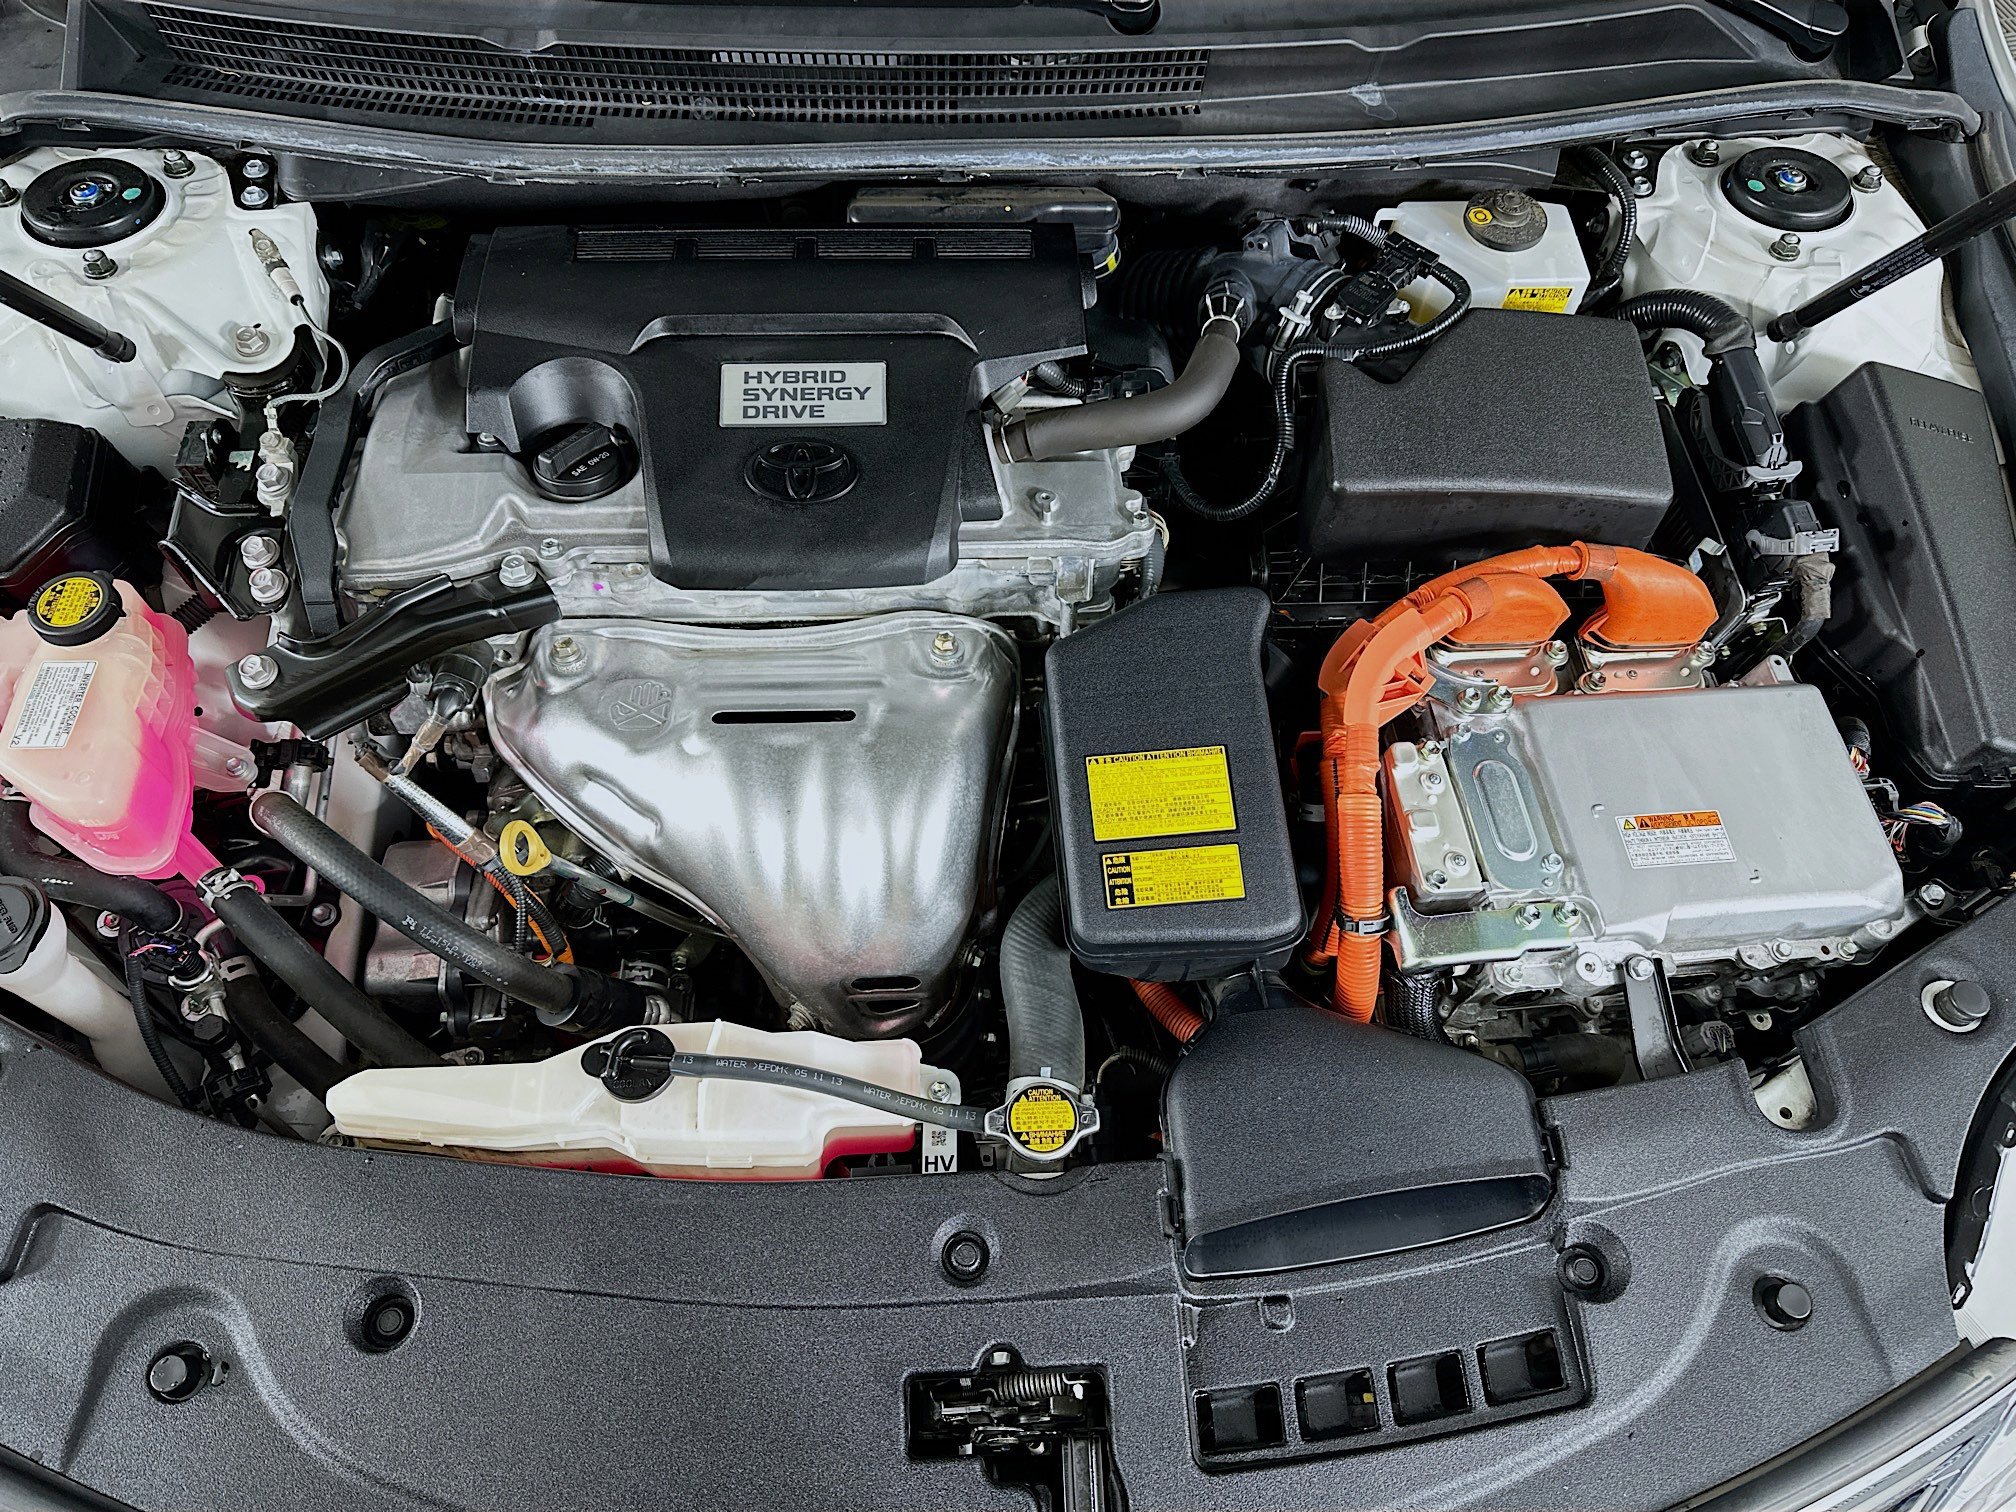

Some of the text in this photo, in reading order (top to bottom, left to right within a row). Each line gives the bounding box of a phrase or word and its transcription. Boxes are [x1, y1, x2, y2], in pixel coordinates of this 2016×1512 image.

[743, 370, 847, 385] HYBRID
[742, 386, 872, 402] SYNERGY
[742, 404, 825, 419] DRIVE
[571, 451, 610, 477] SAE 0W-20
[62, 673, 91, 735] INVERTER COOLANT
[1113, 754, 1144, 763] CAUTION
[1146, 750, 1185, 760] ATTENTION
[1107, 865, 1131, 875] CAUTION
[1109, 877, 1132, 886] ATTENTION
[682, 1055, 694, 1065] 13
[715, 1058, 747, 1069] WATER
[813, 1072, 824, 1082] 11
[831, 1076, 843, 1086] 13
[1027, 1088, 1054, 1096] CAUTION
[863, 1085, 891, 1099] WATER
[949, 1108, 959, 1118] 11
[965, 1111, 977, 1121] 13
[924, 1154, 955, 1173] HV
